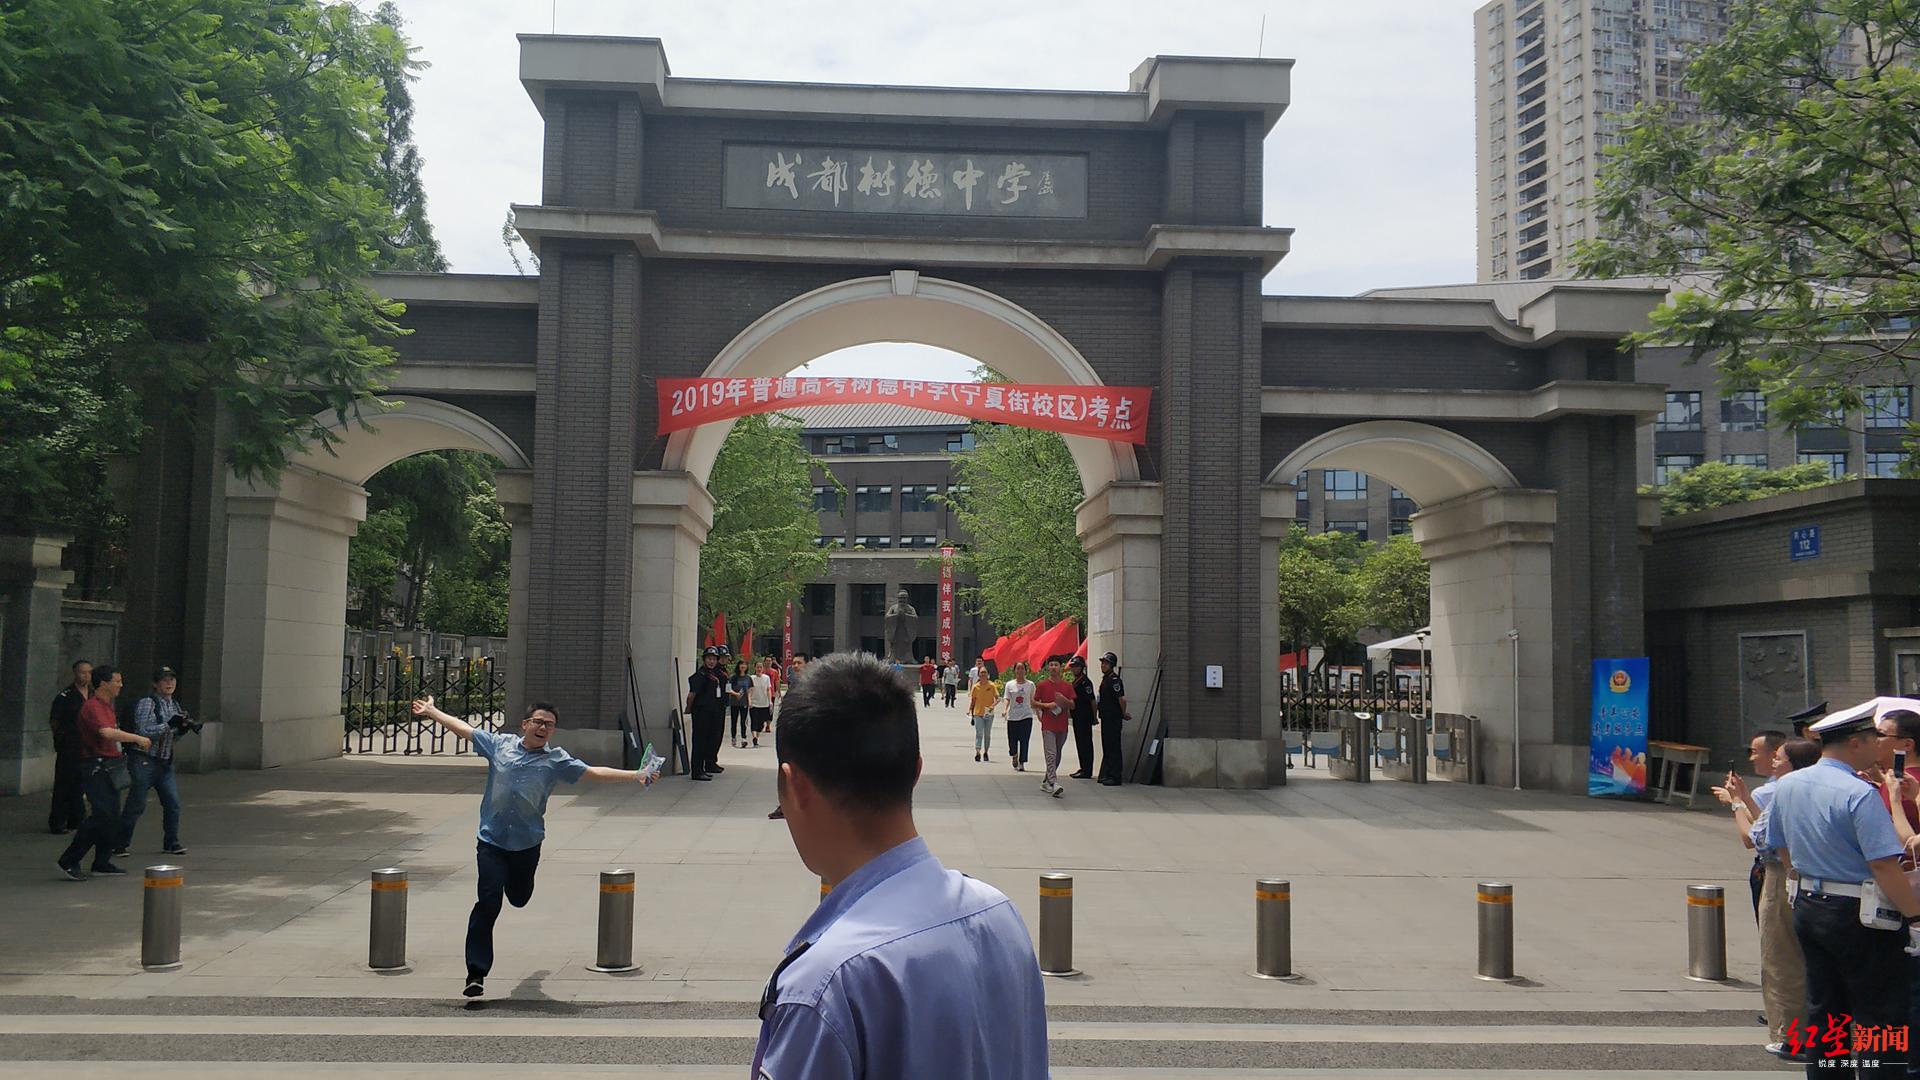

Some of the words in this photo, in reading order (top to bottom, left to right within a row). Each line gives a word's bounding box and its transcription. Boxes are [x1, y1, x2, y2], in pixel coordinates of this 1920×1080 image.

[766, 152, 1031, 210] 成都树德中学
